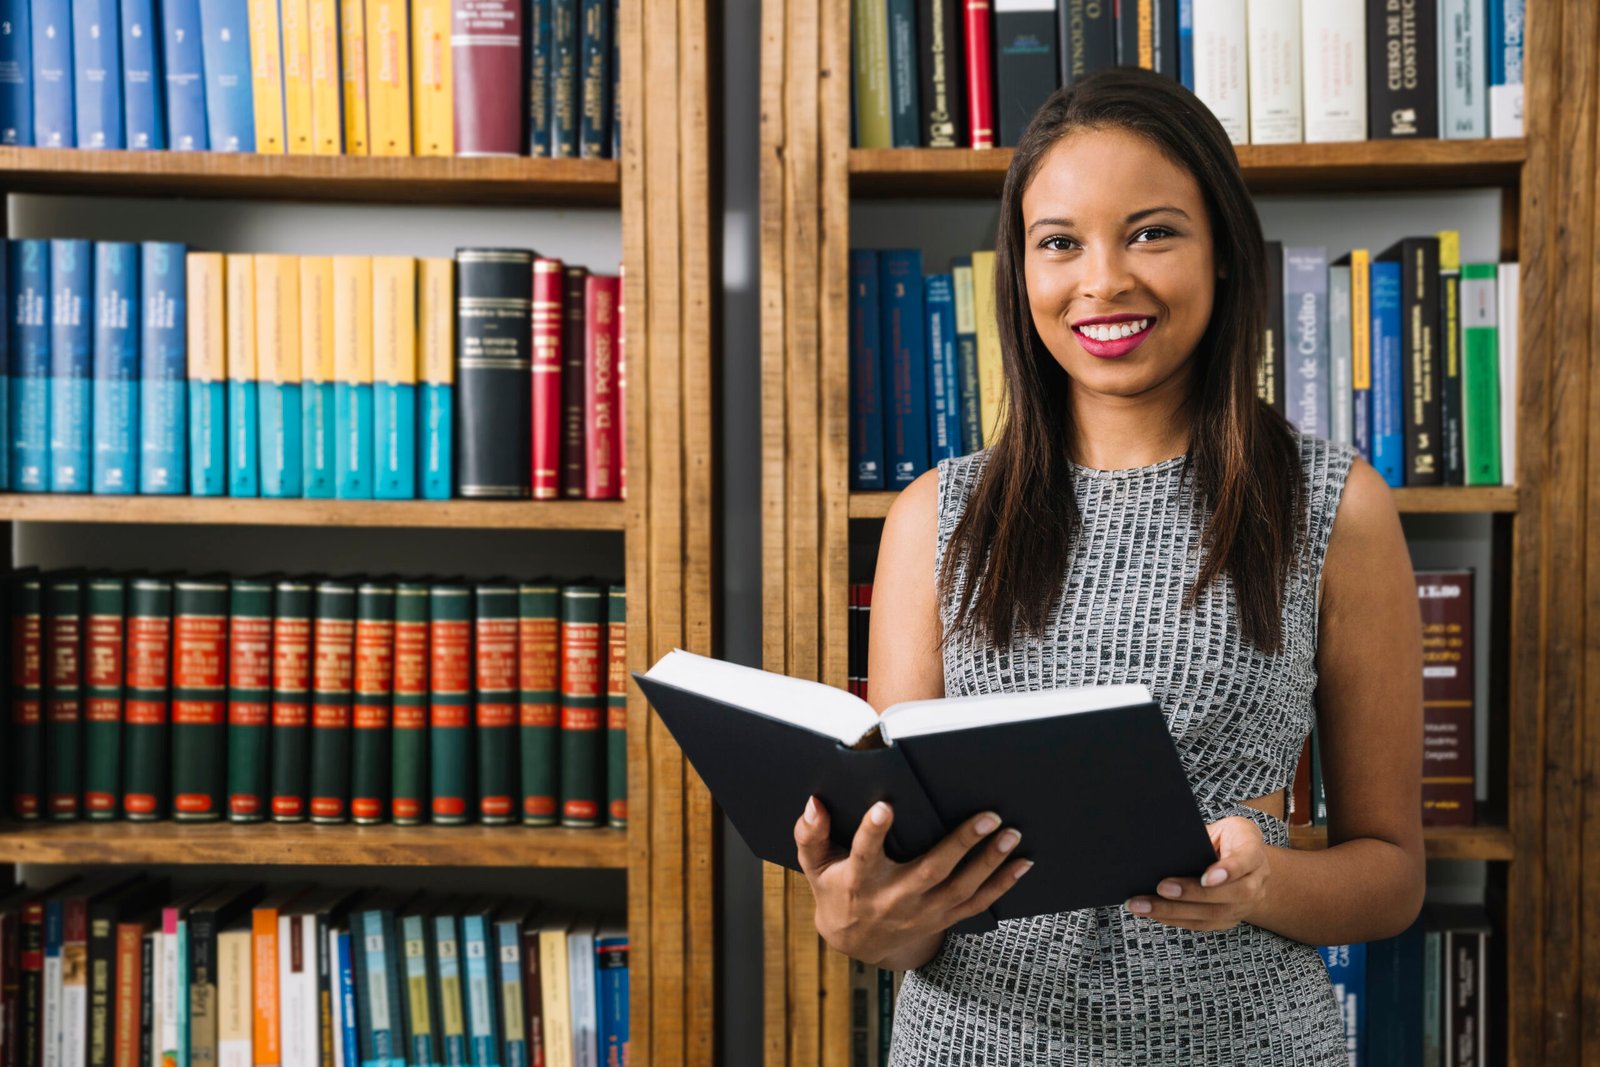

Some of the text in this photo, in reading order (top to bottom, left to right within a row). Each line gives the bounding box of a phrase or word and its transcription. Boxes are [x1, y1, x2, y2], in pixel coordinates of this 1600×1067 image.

[131, 23, 142, 38] 6
[175, 28, 186, 43] 7
[1387, 15, 1402, 90] CURSO DE
[22, 240, 38, 273] 2
[931, 312, 942, 360] COMERCIAL
[1298, 292, 1317, 356] Crédito
[595, 332, 610, 394] POSSE
[1298, 358, 1317, 380] de
[934, 363, 944, 396] DIREITO
[596, 402, 610, 428] DA
[936, 399, 945, 410] DE
[1298, 381, 1317, 434] Títulos
[936, 414, 947, 446] MANUAL
[1425, 752, 1458, 761] Delgado
[506, 948, 514, 959] 5
[190, 966, 208, 1017] Lógica
